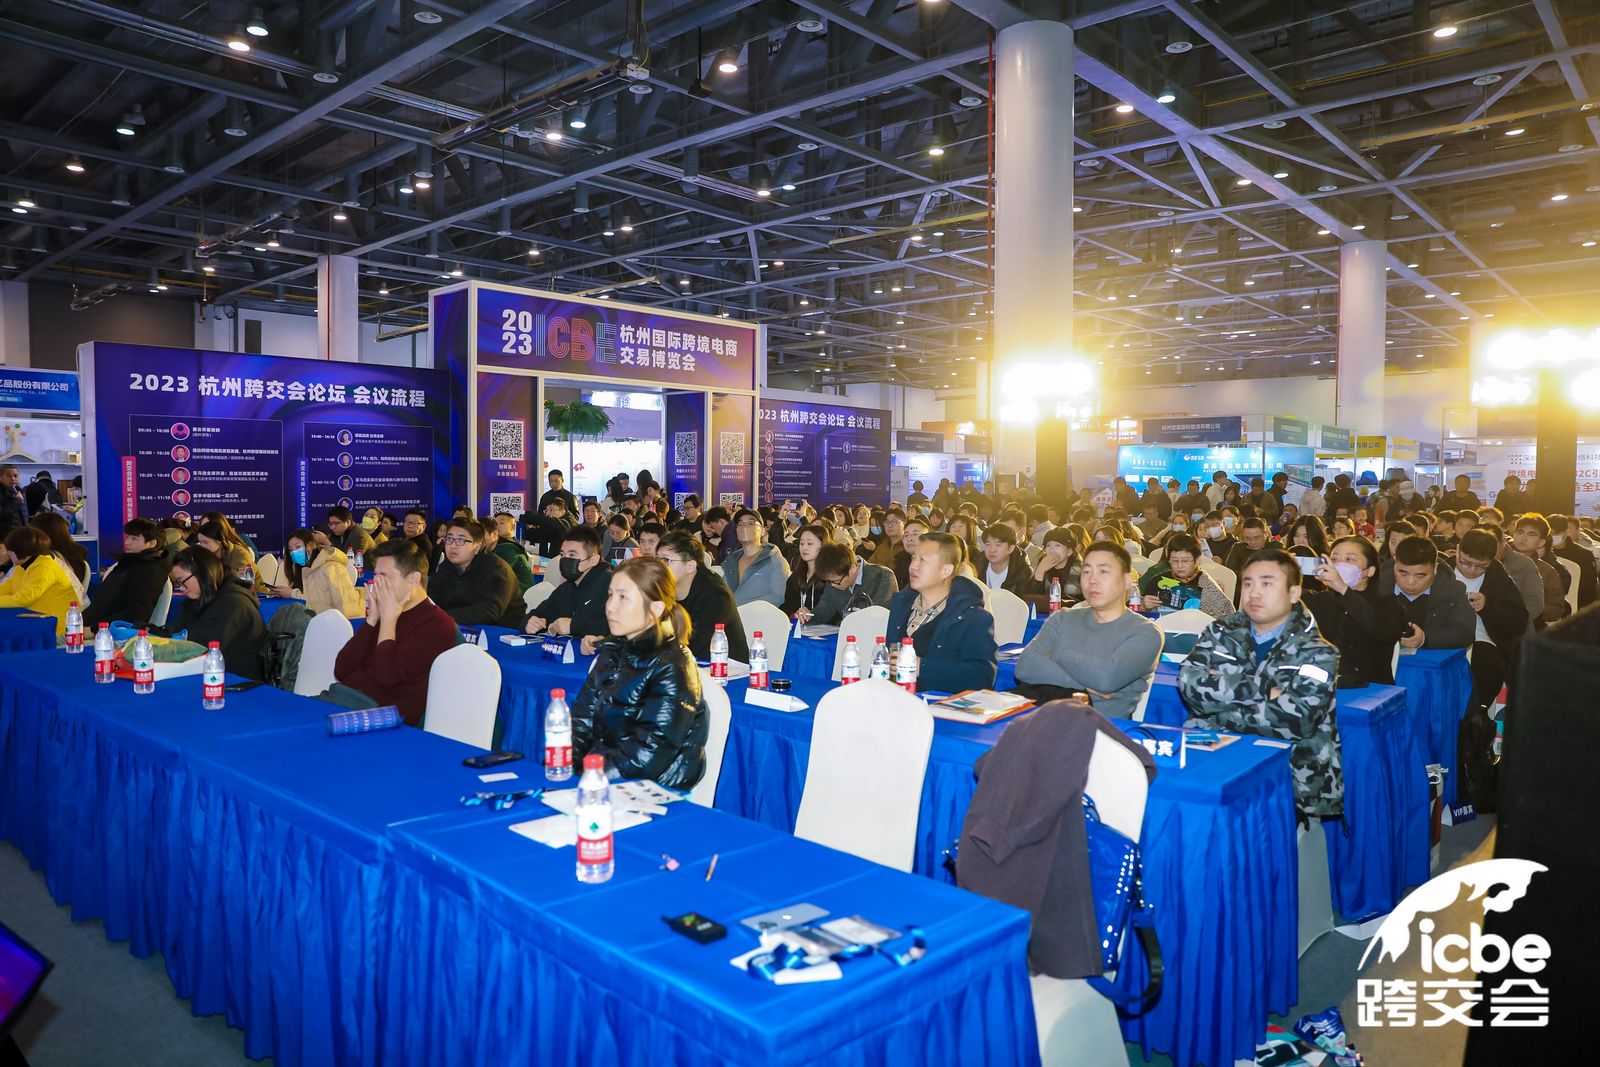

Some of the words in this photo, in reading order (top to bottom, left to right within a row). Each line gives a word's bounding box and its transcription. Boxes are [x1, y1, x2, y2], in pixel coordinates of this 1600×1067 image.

[502, 309, 533, 333] 20
[502, 331, 533, 355] 23
[535, 313, 617, 364] ICBE
[620, 324, 738, 357] 杭州国际跨境电商
[620, 346, 696, 372] 交易博览会
[129, 374, 189, 393] 2023
[198, 375, 347, 404] 杭州跨交会论坛
[353, 386, 426, 408] 会议流程
[780, 408, 845, 427] 杭州跨交会论坛
[847, 415, 881, 430] 会议流程
